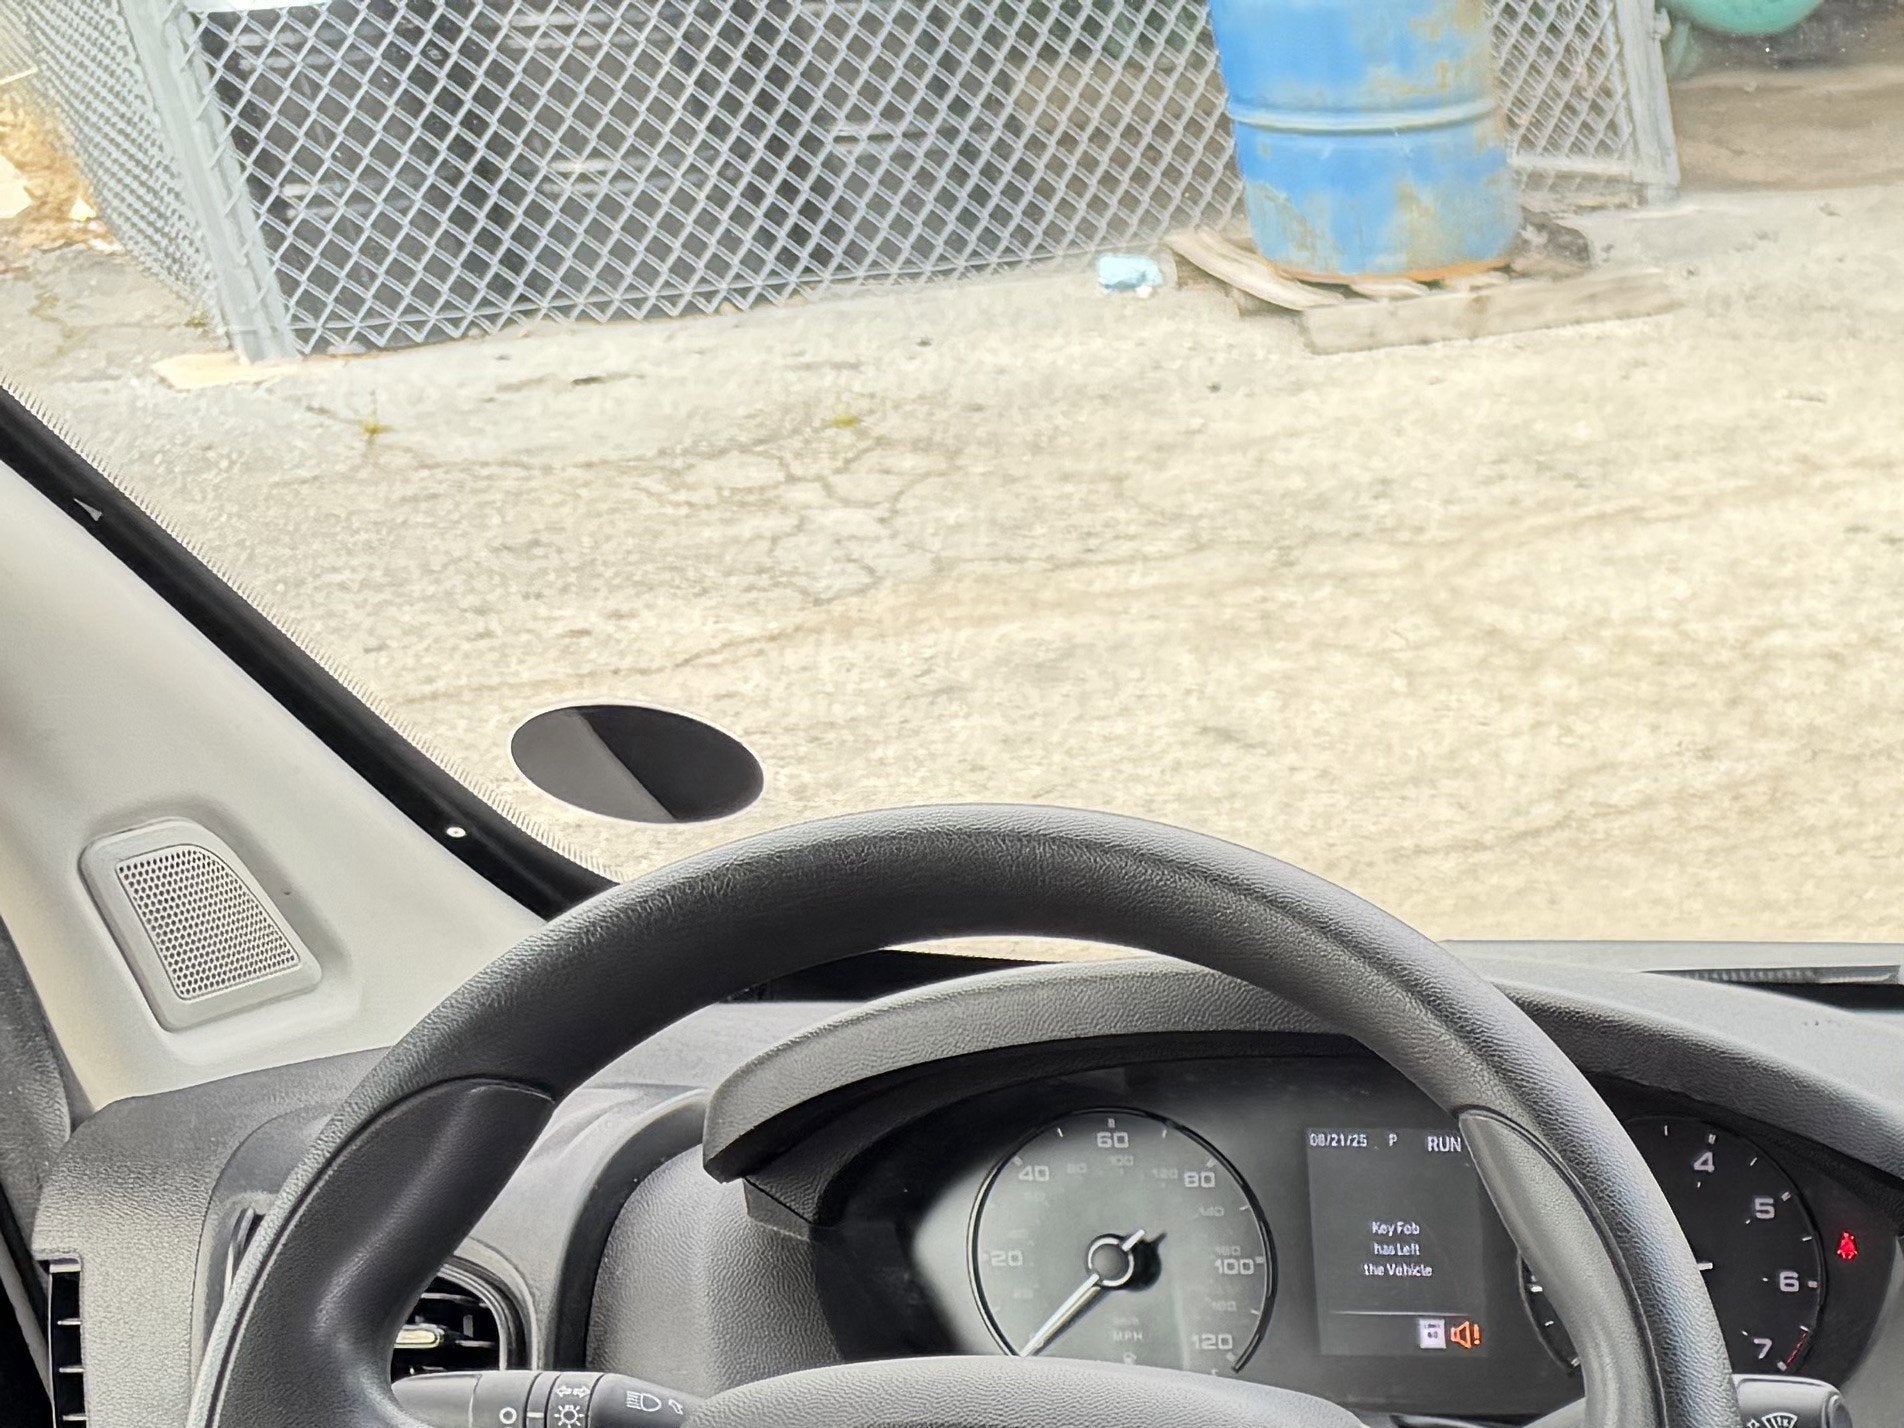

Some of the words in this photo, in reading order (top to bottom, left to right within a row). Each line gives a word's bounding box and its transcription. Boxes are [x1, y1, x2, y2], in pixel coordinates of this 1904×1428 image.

[1097, 1132, 1129, 1148] 60
[1389, 1133, 1398, 1146] P
[1427, 1136, 1462, 1152] RUN
[1694, 1152, 1715, 1173] 4
[1018, 1165, 1049, 1182] 40
[1184, 1171, 1215, 1188] 80
[1754, 1197, 1776, 1219] 5
[1372, 1221, 1395, 1237] Key
[1396, 1221, 1420, 1235] Fob
[1374, 1242, 1396, 1255] has
[1397, 1243, 1420, 1256] Left
[990, 1250, 1023, 1267] 20
[1215, 1258, 1255, 1276] 100
[1363, 1263, 1385, 1276] the
[1386, 1262, 1433, 1277] Vehicle
[1779, 1271, 1800, 1292] 6
[1192, 1334, 1233, 1350] 120
[1753, 1337, 1773, 1359] 7
